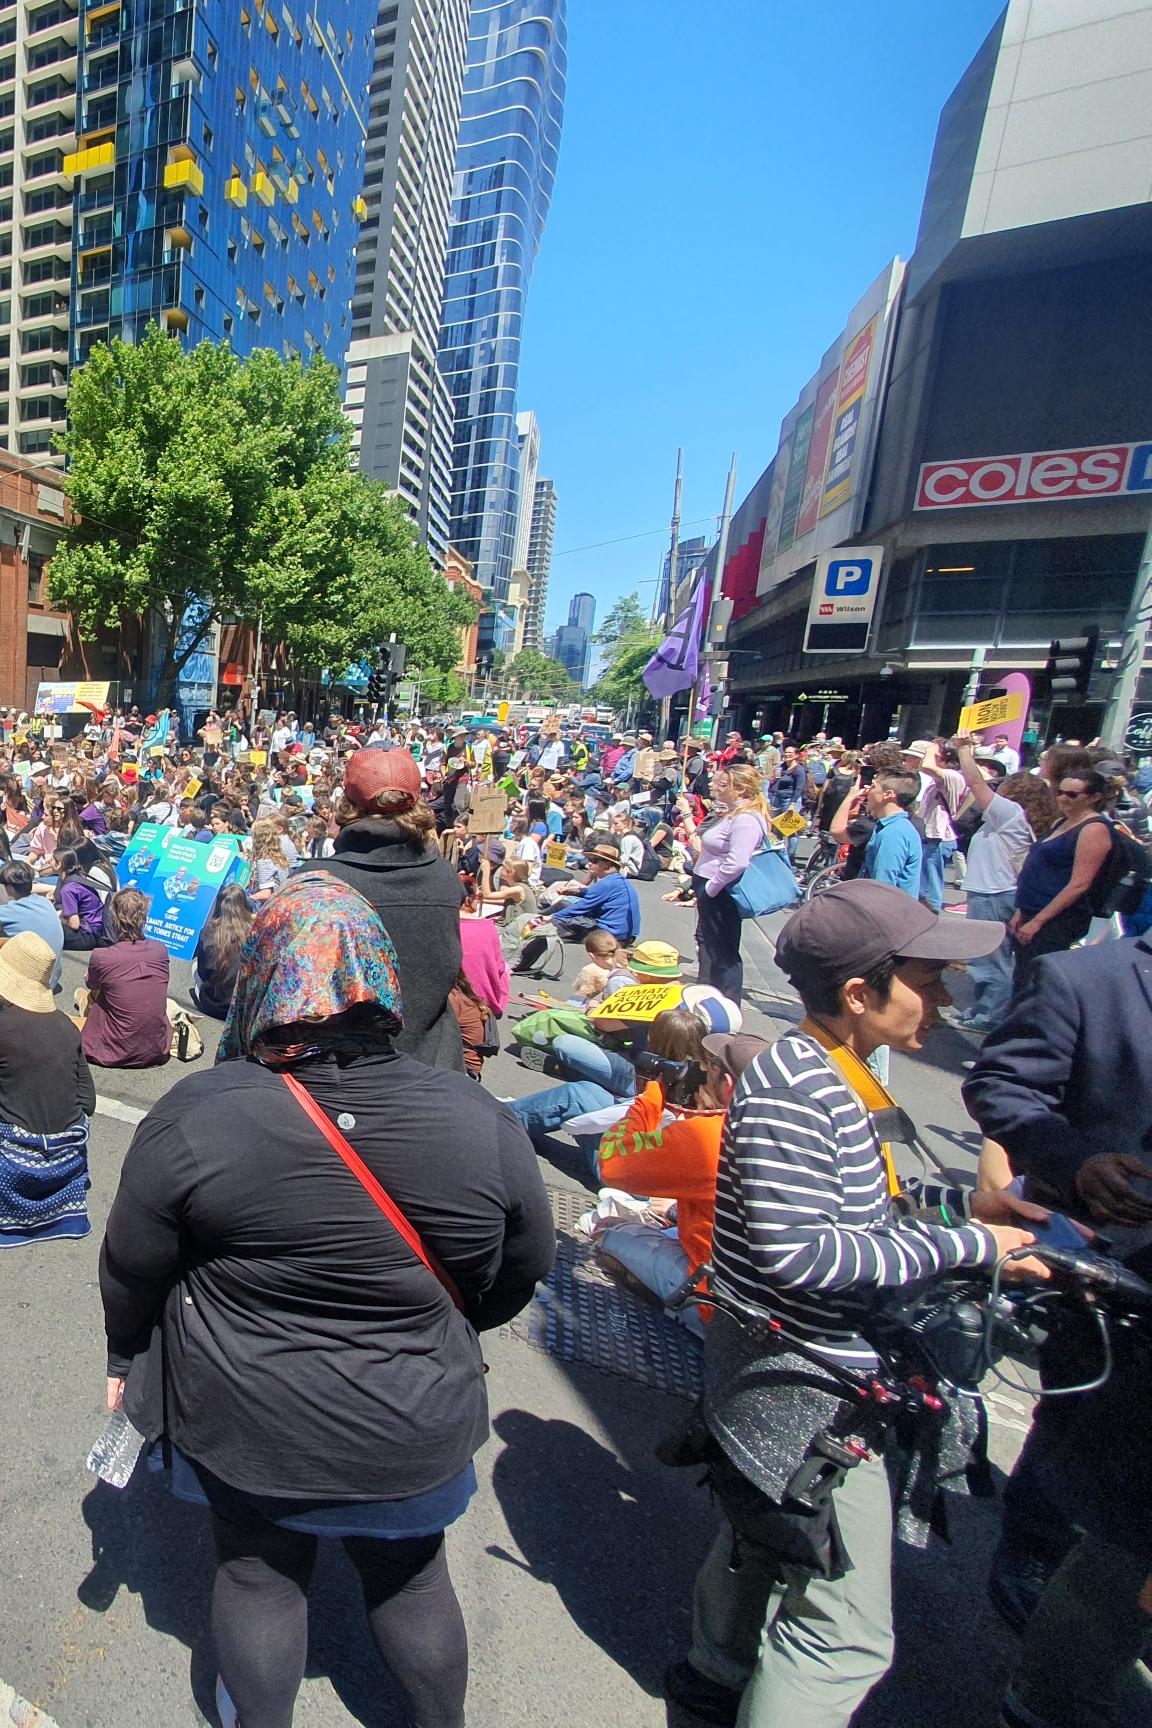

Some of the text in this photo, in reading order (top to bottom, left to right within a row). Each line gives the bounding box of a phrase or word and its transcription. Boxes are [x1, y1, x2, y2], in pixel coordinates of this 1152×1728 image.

[924, 453, 1120, 503] coles
[836, 566, 862, 590] P
[183, 927, 195, 937] FOR
[614, 986, 673, 998] CLIMATE
[615, 993, 668, 1004] ACTION
[599, 1000, 662, 1015] NOW
